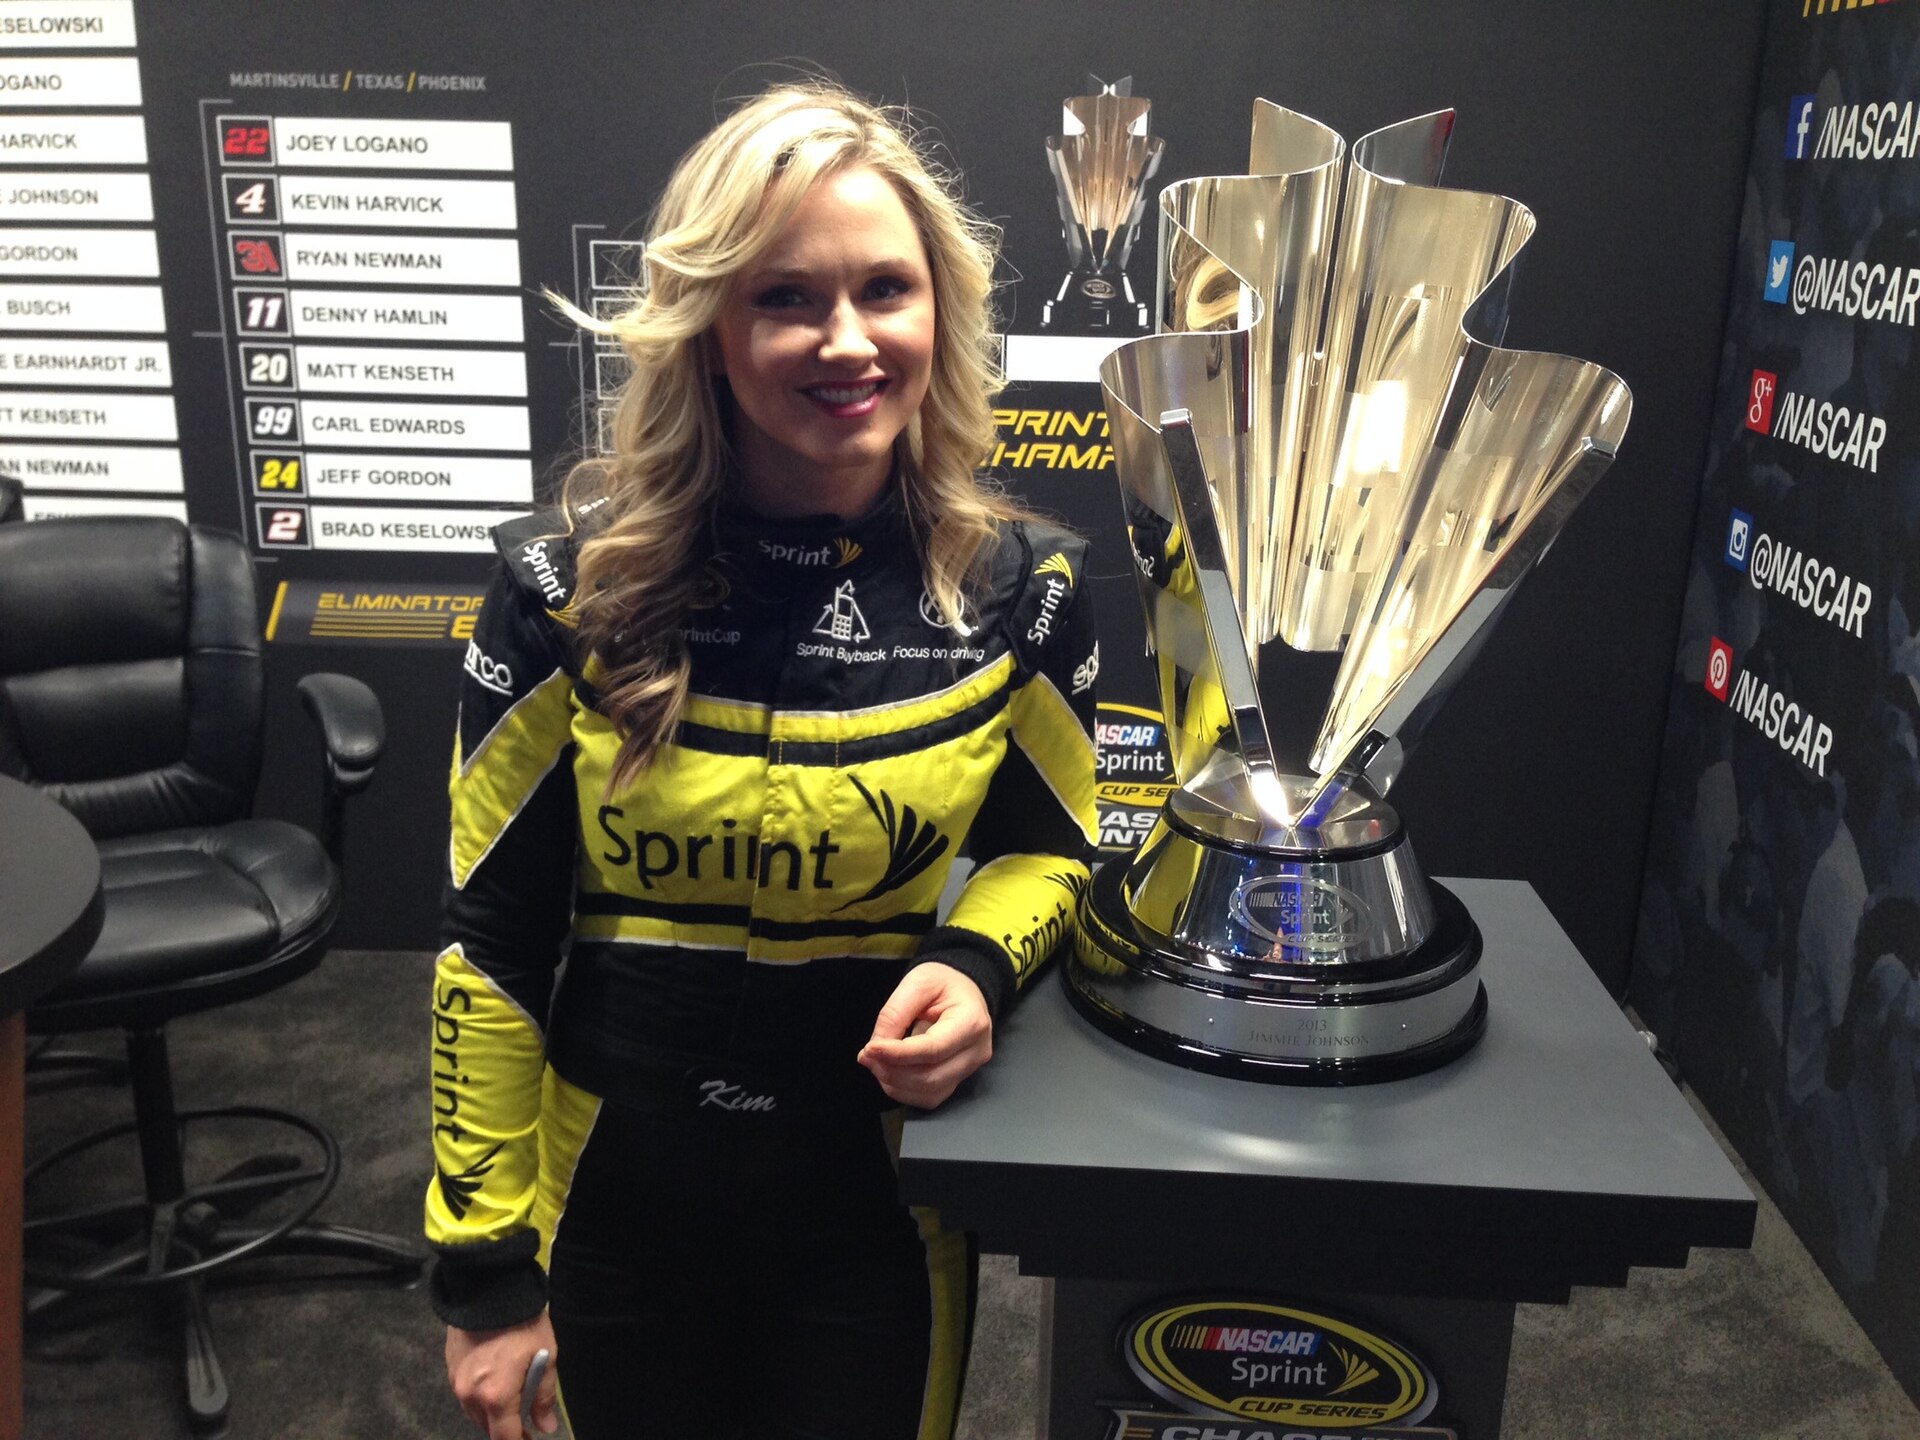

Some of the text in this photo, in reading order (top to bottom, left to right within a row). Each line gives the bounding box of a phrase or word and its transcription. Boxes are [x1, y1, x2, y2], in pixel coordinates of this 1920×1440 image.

[356, 74, 404, 90] TEXAS
[418, 74, 486, 91] PHOENIX
[224, 128, 428, 155] 22 JOEY LOGANO
[8, 189, 98, 204] JOHNSON
[235, 183, 443, 214] 4 KEVIN HARVICK
[297, 250, 348, 267] RYAN
[355, 251, 442, 270] NEWMAN
[1793, 254, 1920, 326] @NASCAR
[8, 300, 71, 315] BUSCH
[247, 297, 447, 328] 11 DENNY HAMLIN
[13, 354, 127, 371] EARNHARDT
[134, 358, 162, 373] JR.
[250, 353, 454, 384] 20 MATT KENSETH
[20, 408, 107, 425] KENSETH
[254, 406, 466, 436] 99 CARL EDWARDS
[26, 459, 109, 476] NEWMAN
[259, 459, 451, 489] 24 JEFF GORDON
[267, 511, 301, 541] 2
[321, 521, 375, 538] BRAD
[759, 540, 831, 566] Sprint
[522, 541, 566, 603] Sprint
[1750, 532, 1873, 639] @NASCAR
[1027, 578, 1066, 646] Sprint
[796, 642, 834, 658] Sprint
[893, 645, 930, 659] Focus
[932, 648, 948, 659] on
[1096, 749, 1165, 776] Sprint
[1100, 785, 1140, 797] CUP
[598, 804, 840, 890] Sprint
[1003, 901, 1067, 978] Sprint
[1298, 1019, 1327, 1031] 2013
[432, 983, 471, 1143] Sprint
[699, 1080, 777, 1111] Kim
[1217, 1328, 1317, 1355] NASCAR
[1231, 1356, 1328, 1388] Sprint
[1239, 1400, 1388, 1420] CUP SERIES
